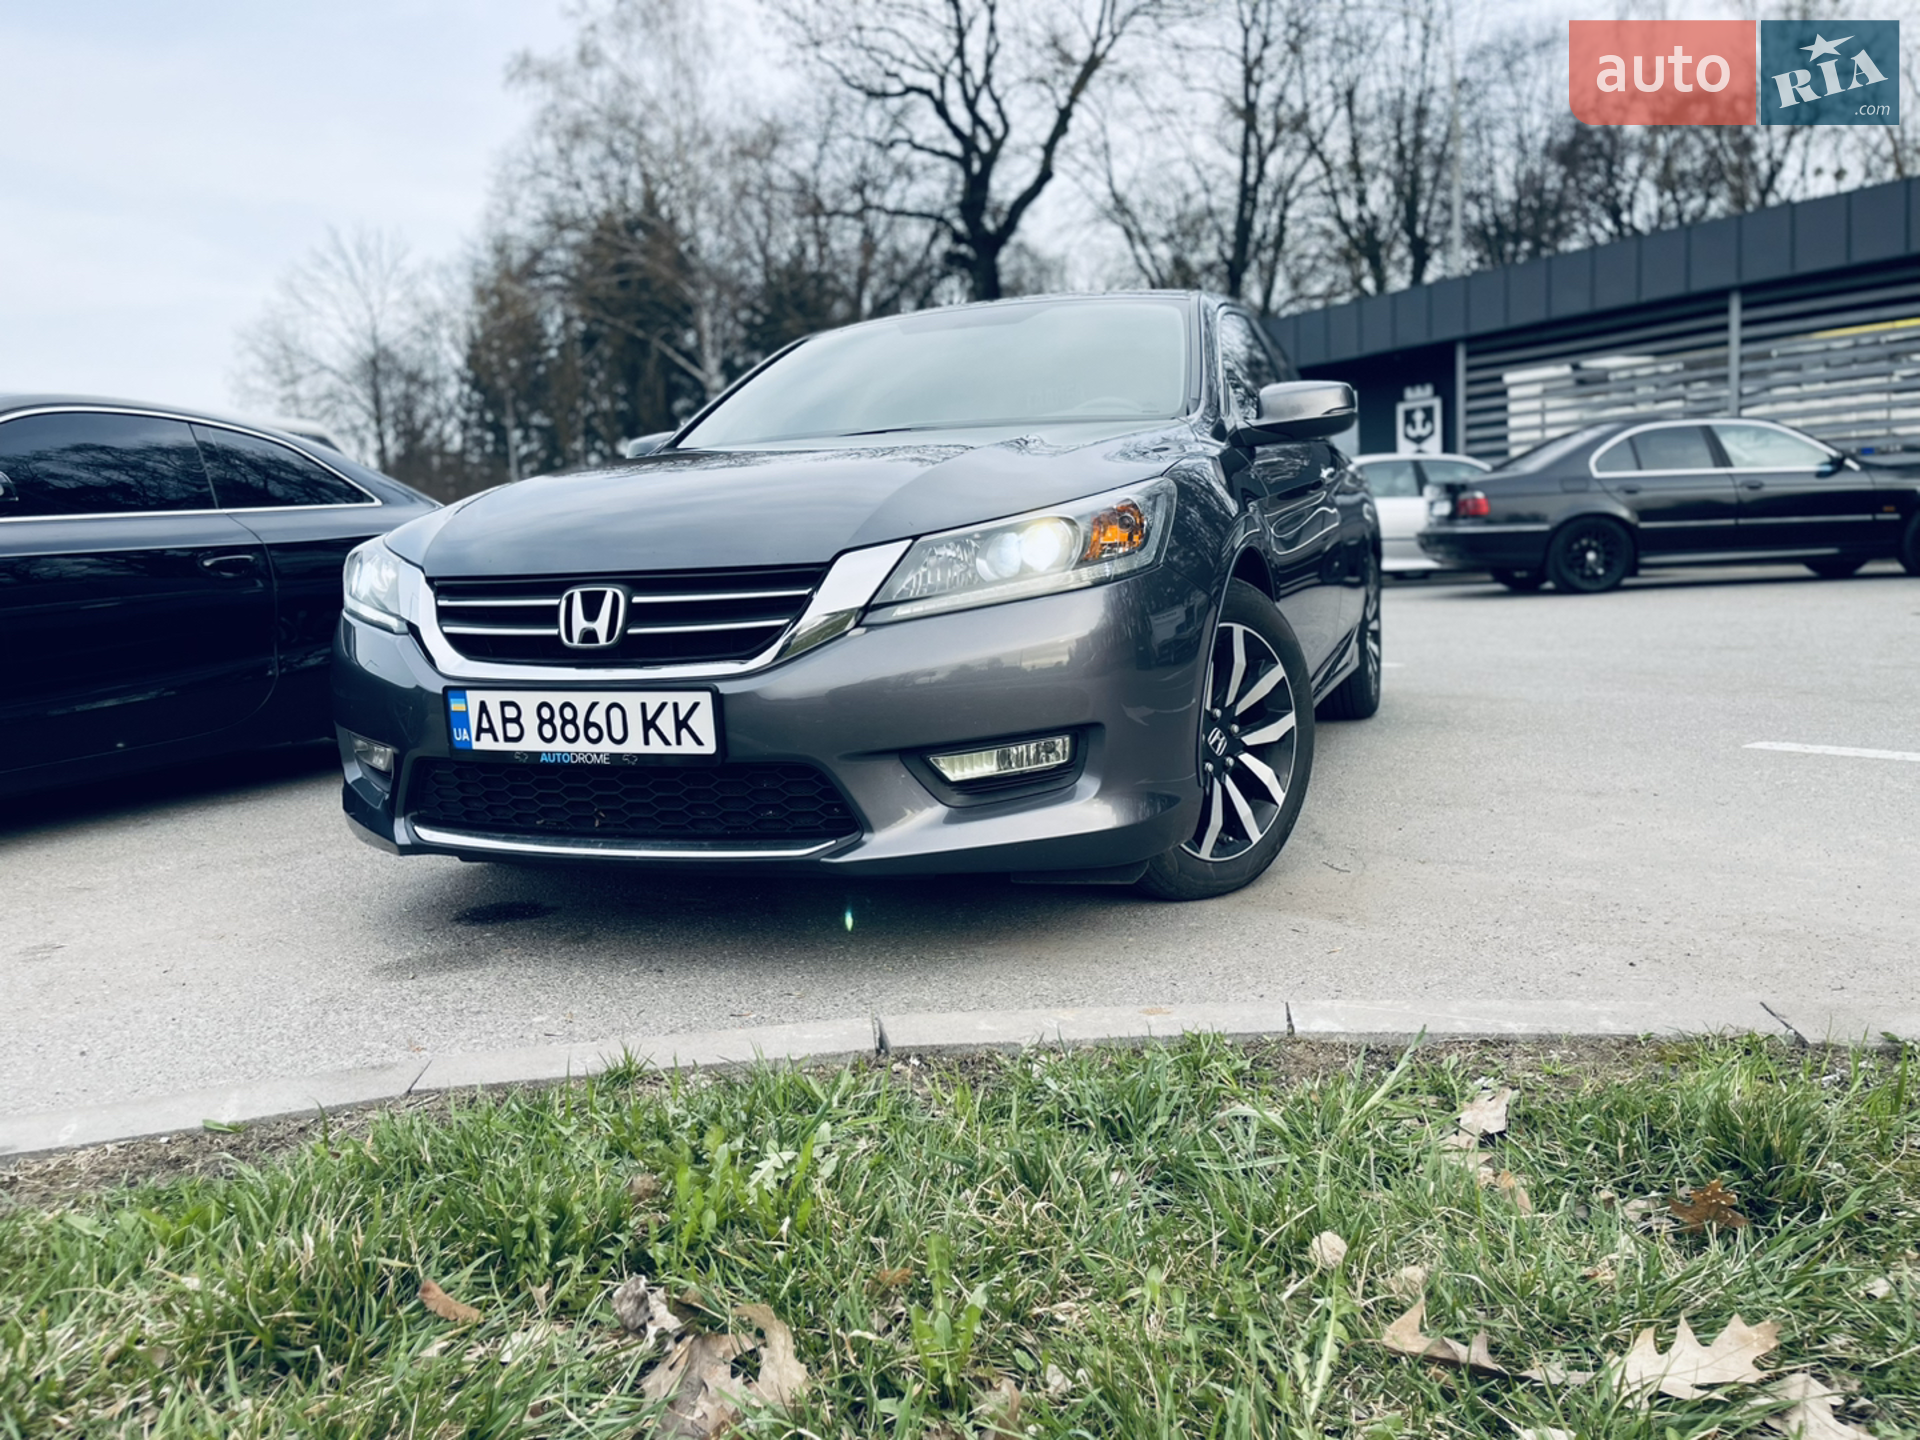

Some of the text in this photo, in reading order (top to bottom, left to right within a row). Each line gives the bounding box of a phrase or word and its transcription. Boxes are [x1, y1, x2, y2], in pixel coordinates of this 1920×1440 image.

[474, 700, 705, 747] AB 8860 KK
[453, 727, 471, 742] UA
[540, 752, 611, 765] AUTODROME
